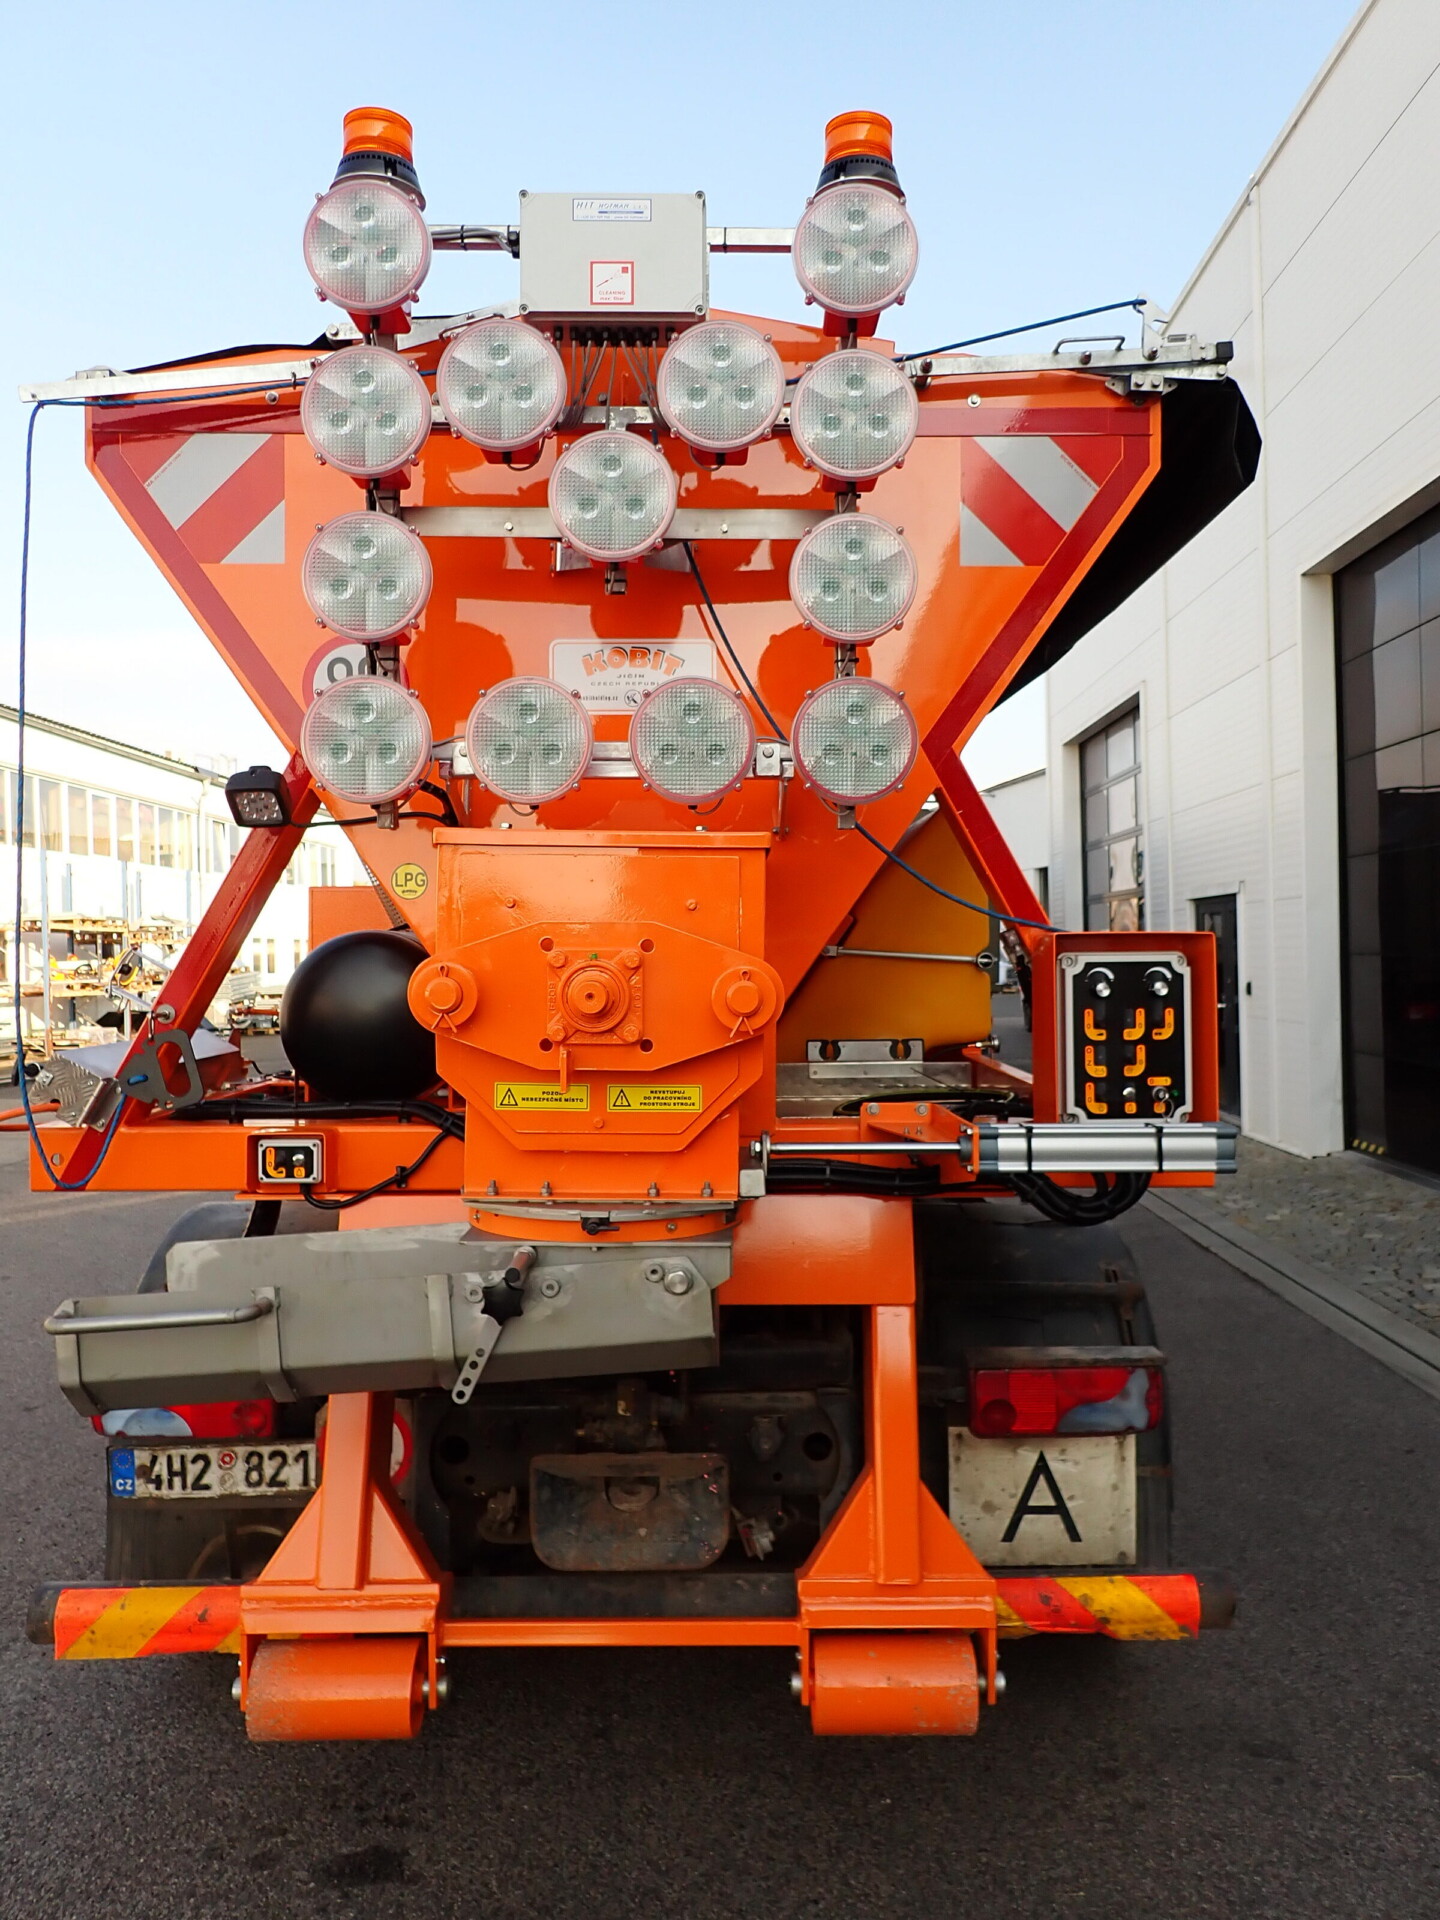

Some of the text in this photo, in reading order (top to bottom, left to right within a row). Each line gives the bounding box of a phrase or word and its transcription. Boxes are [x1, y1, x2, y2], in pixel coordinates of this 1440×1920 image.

[581, 646, 685, 677] KOBIT
[395, 872, 425, 887] LPG
[115, 1478, 133, 1491] CZ
[145, 1450, 309, 1491] 4H2 821
[1001, 1450, 1082, 1542] A
